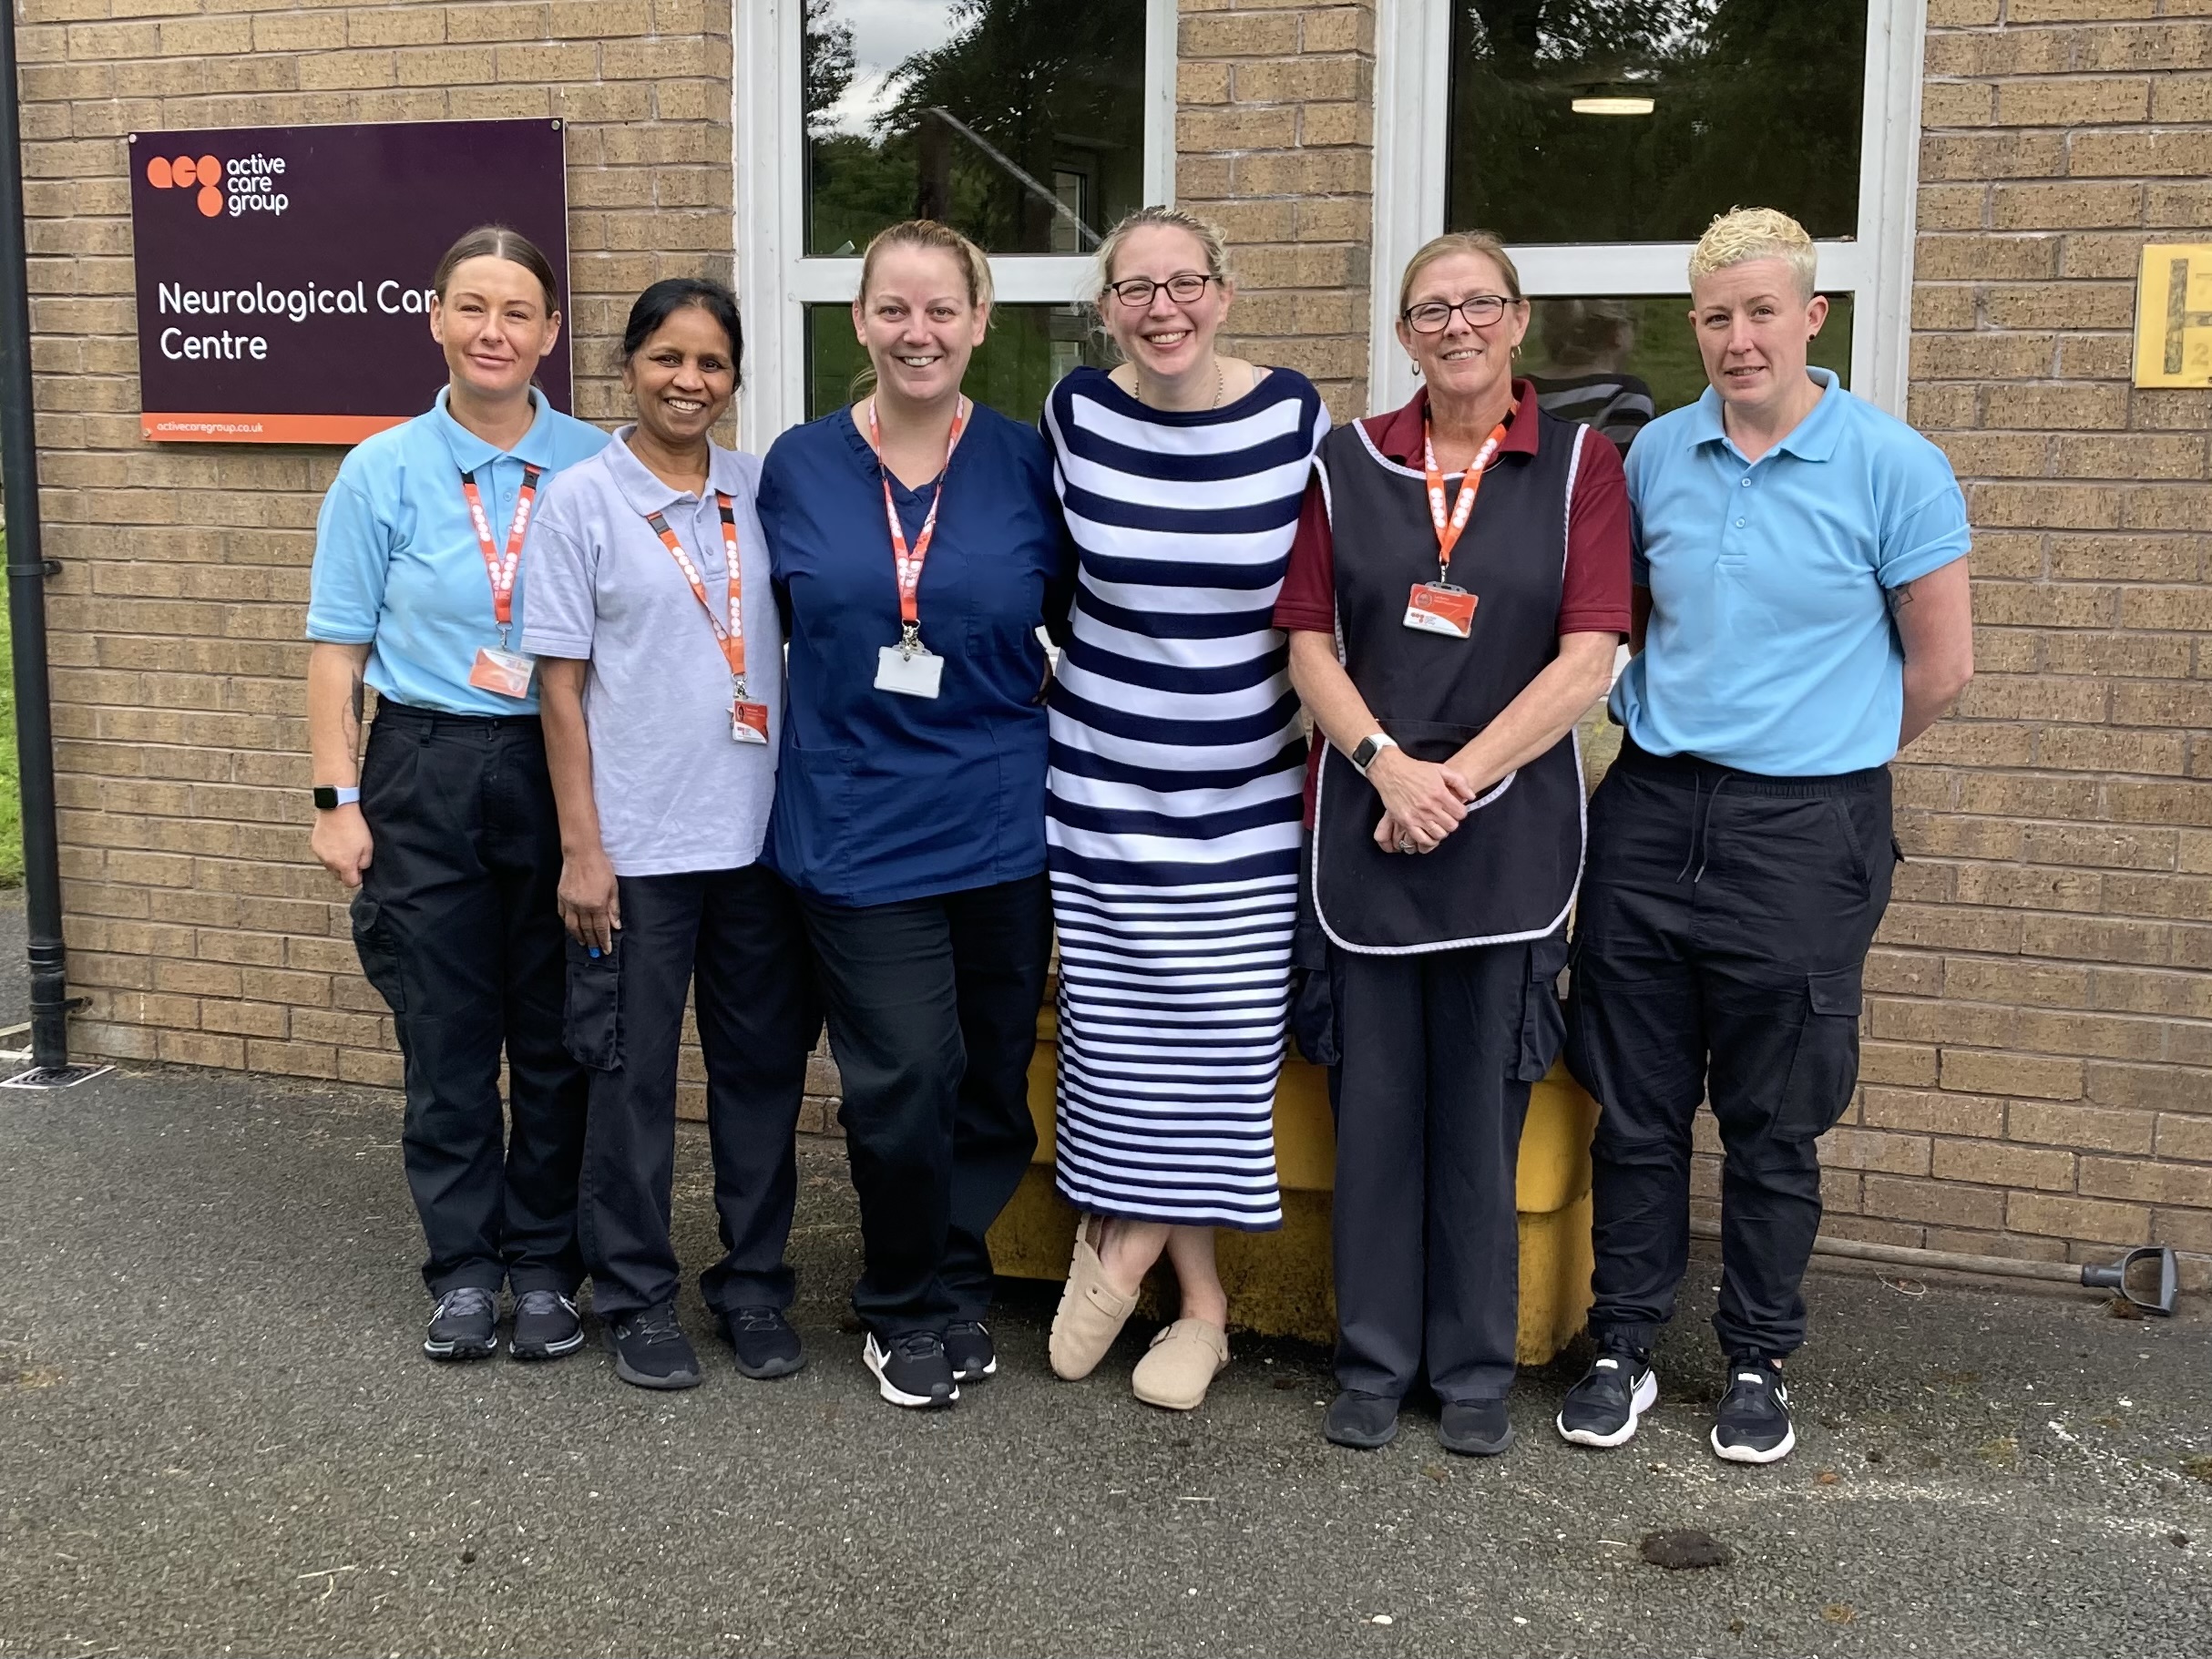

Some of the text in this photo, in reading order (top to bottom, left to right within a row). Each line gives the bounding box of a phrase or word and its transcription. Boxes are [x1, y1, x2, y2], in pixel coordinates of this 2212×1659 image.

[226, 153, 286, 175] active
[227, 175, 272, 193] care
[228, 193, 289, 217] group
[159, 280, 436, 323] Neurological Car
[159, 327, 268, 360] Centre
[156, 420, 264, 435] activecaregroup.co.uk
